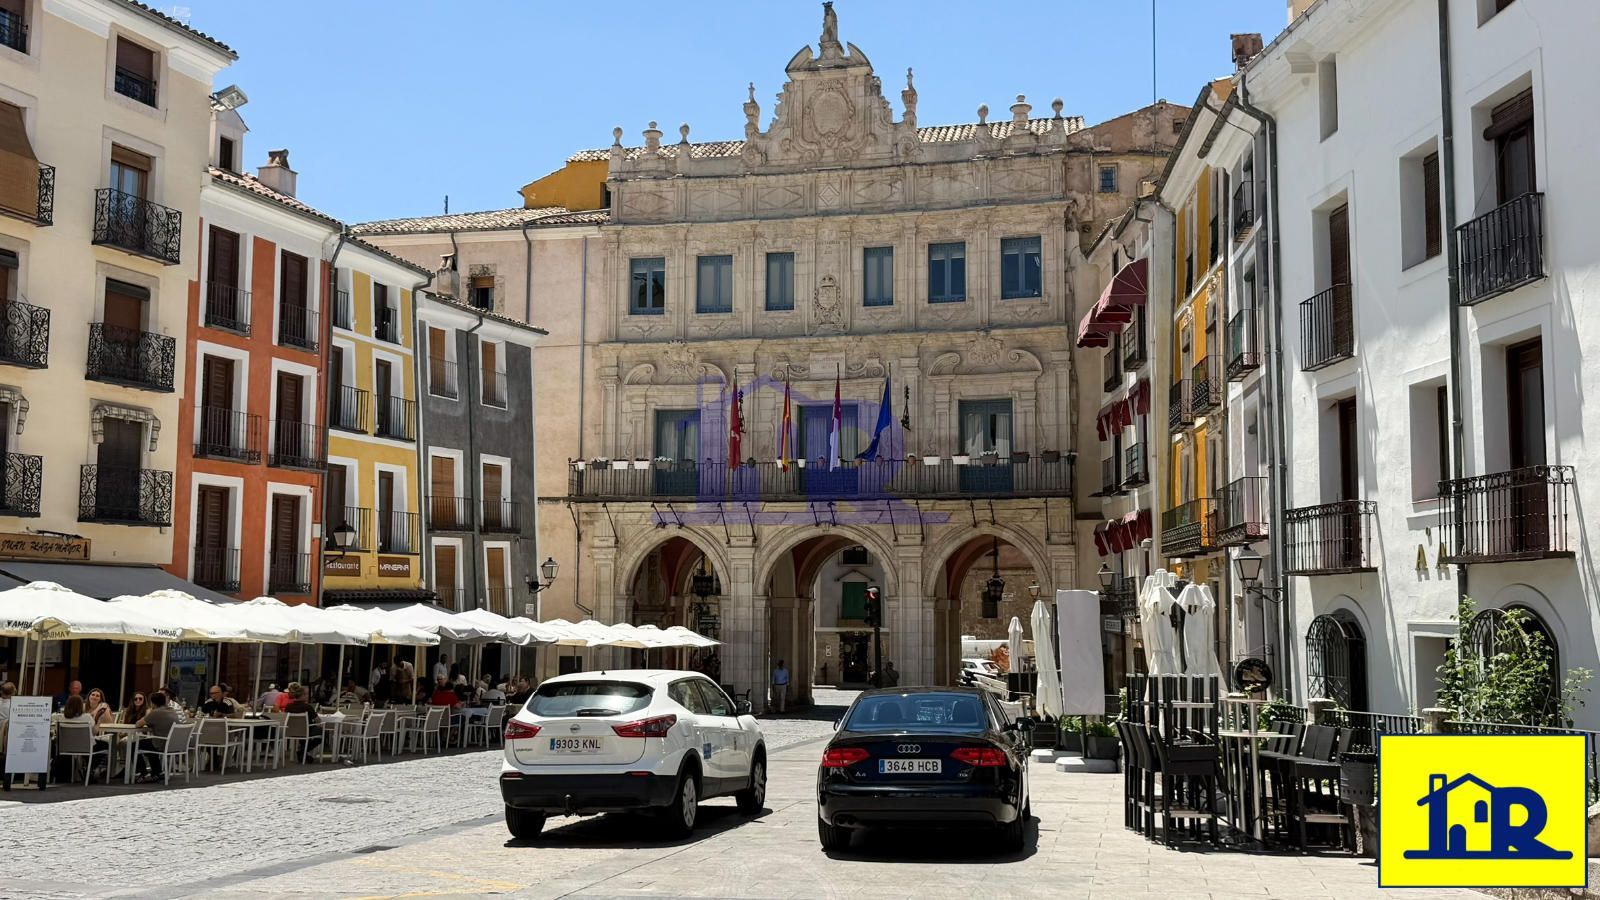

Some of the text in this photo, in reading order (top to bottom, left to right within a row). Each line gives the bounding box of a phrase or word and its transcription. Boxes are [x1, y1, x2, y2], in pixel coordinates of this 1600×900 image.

[171, 648, 206, 658] GUIADAS
[556, 739, 600, 749] 9303 KNL
[887, 761, 938, 772] 3648 HCB
